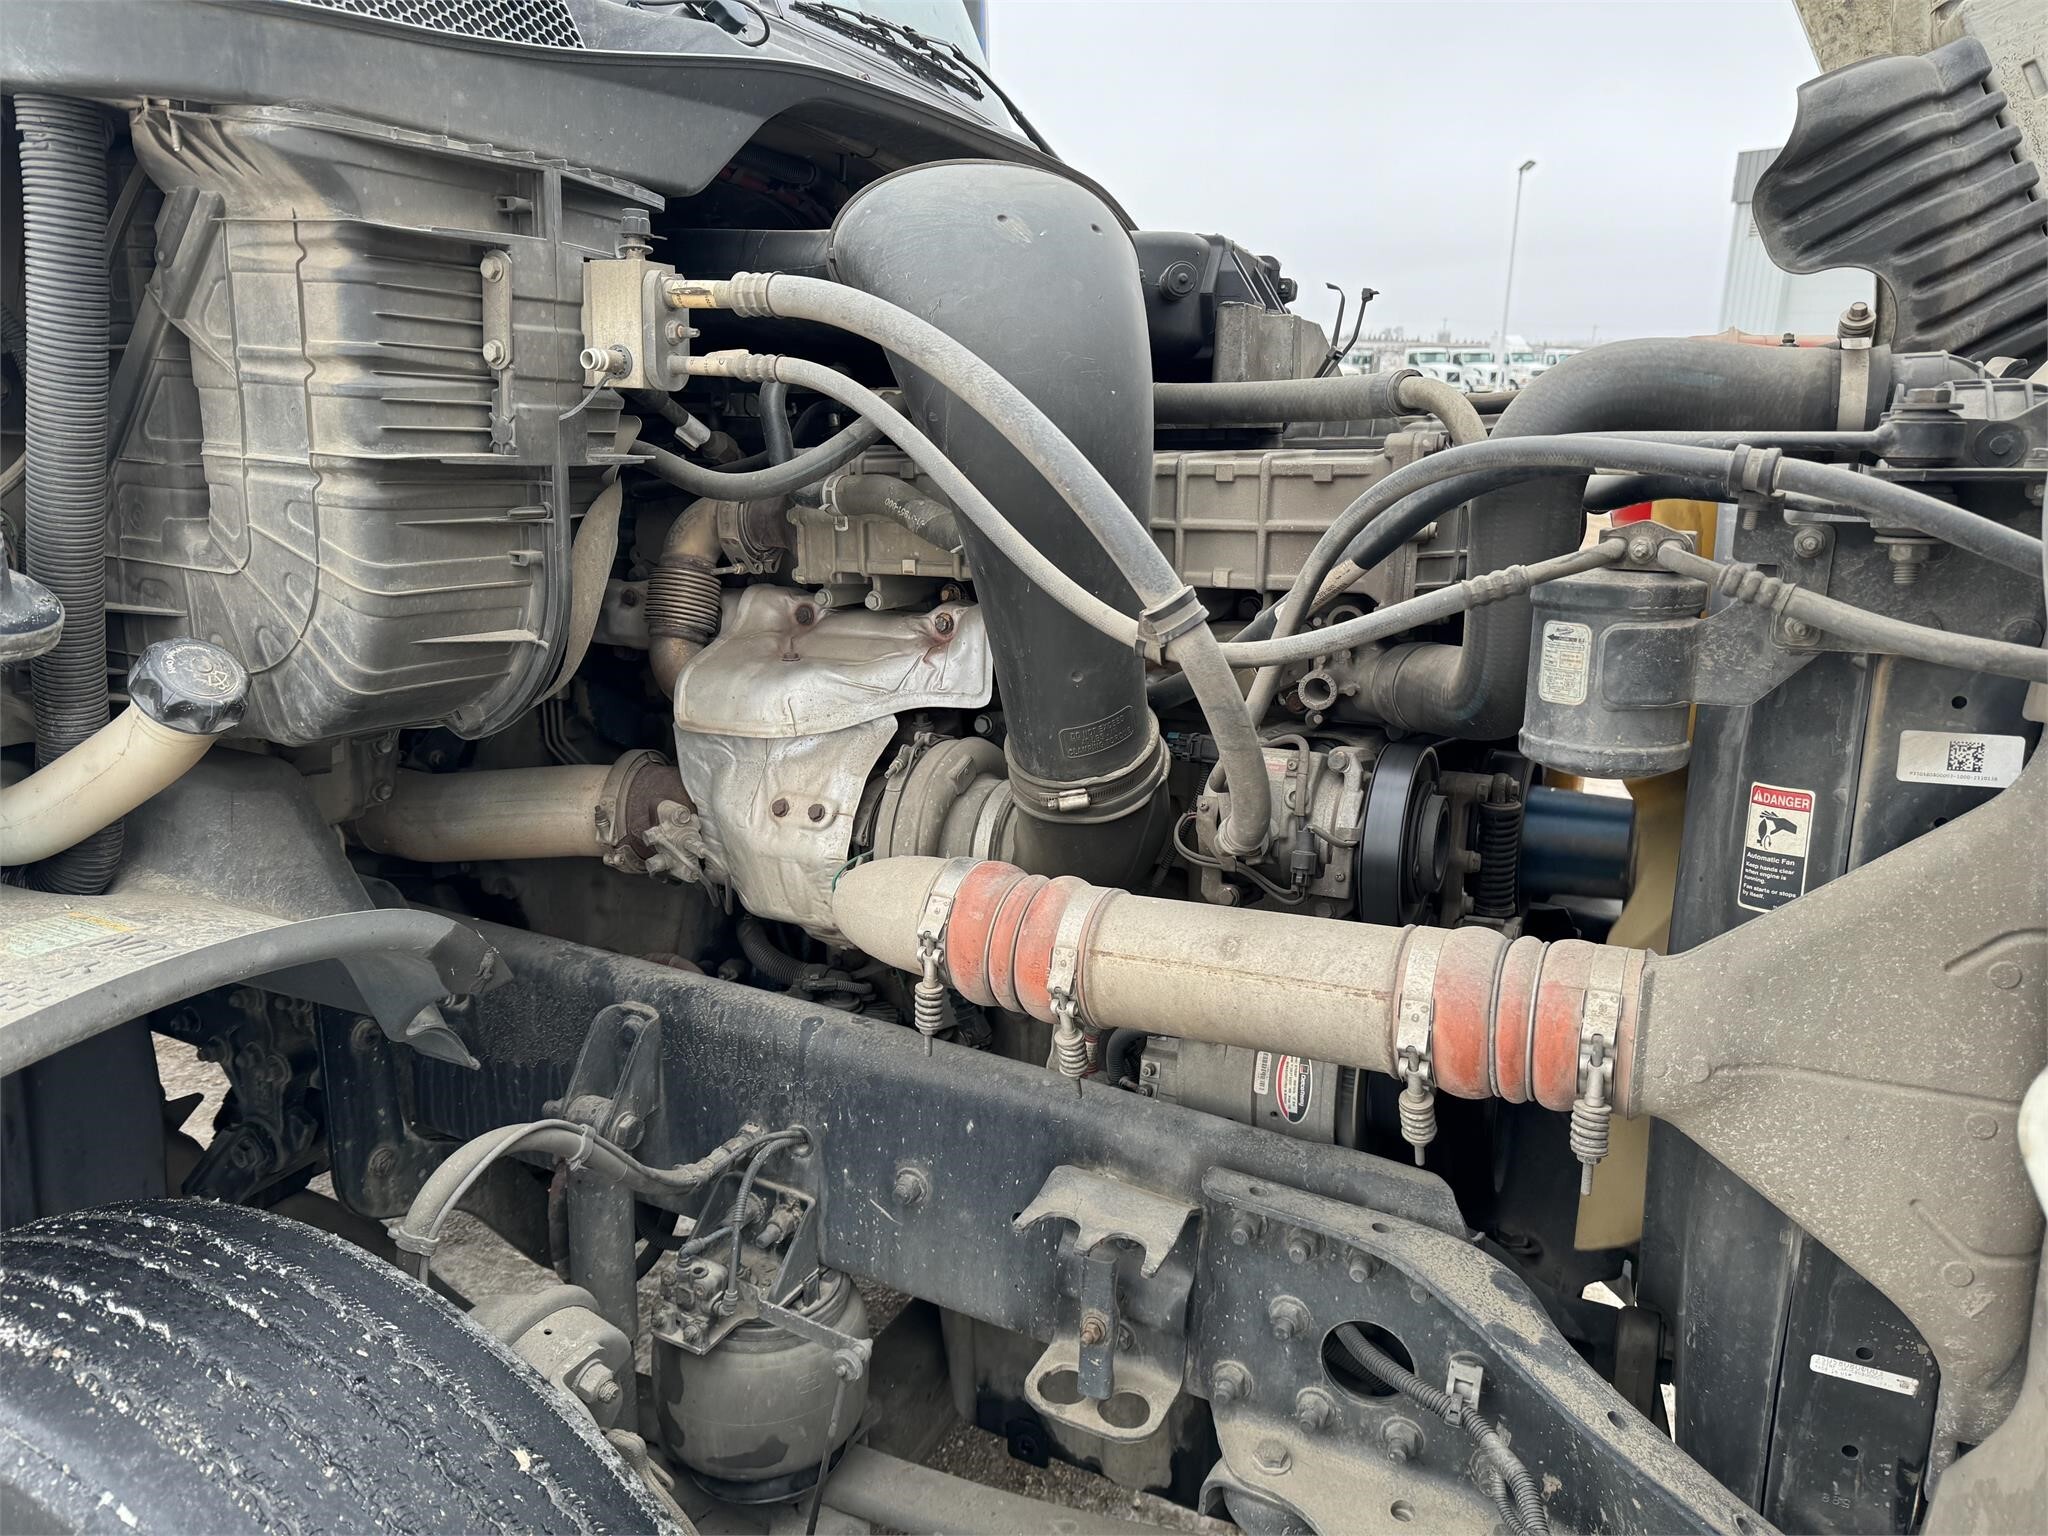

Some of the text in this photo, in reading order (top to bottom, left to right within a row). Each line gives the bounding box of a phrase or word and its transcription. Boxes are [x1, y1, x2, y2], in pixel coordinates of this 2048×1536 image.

[1762, 793, 1810, 810] DANGER
[1747, 851, 1795, 866] Automatic Fan
[1745, 868, 1759, 876] when
[1760, 871, 1780, 881] engine
[1746, 861, 1795, 875] Keep hands clear
[1742, 889, 1749, 897] by
[1743, 882, 1753, 891] Fan
[1753, 885, 1770, 894] starts
[1779, 889, 1797, 899] stops
